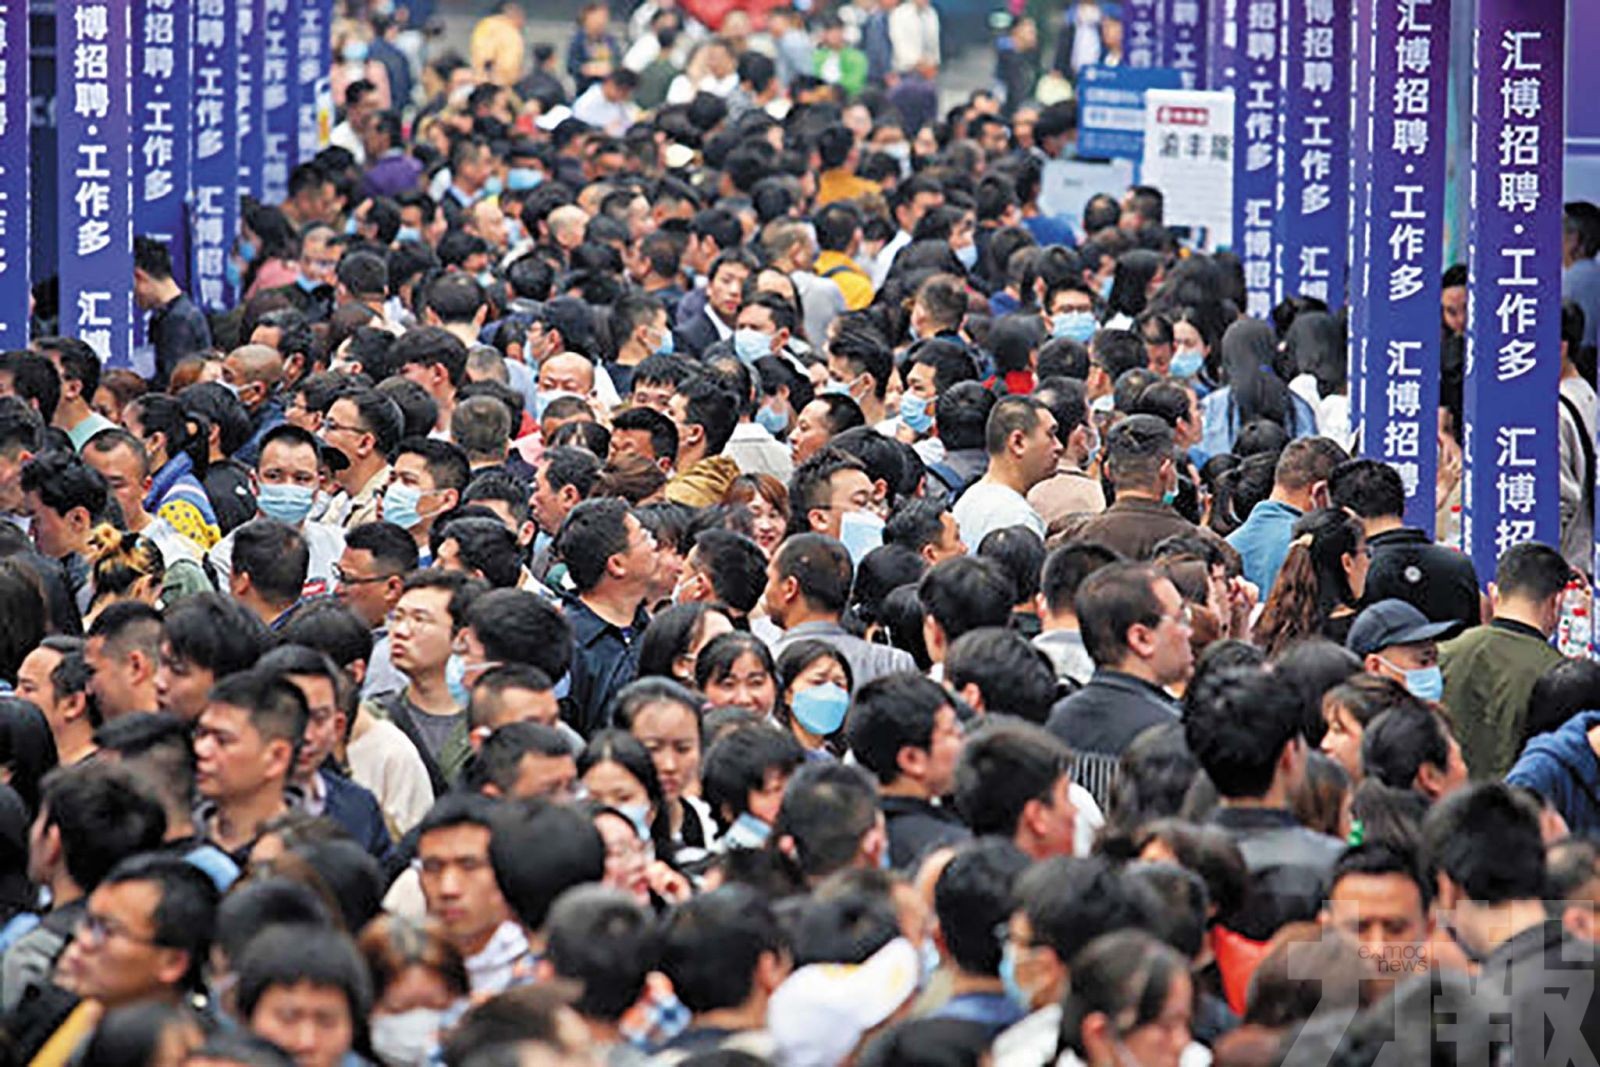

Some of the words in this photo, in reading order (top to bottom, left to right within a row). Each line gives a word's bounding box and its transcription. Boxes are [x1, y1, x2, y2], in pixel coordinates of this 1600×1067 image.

[73, 5, 111, 256] 博招聘·工作多
[1389, 0, 1432, 301] 汇博招聘·工作多
[1496, 30, 1542, 381] 汇博招聘·工作多
